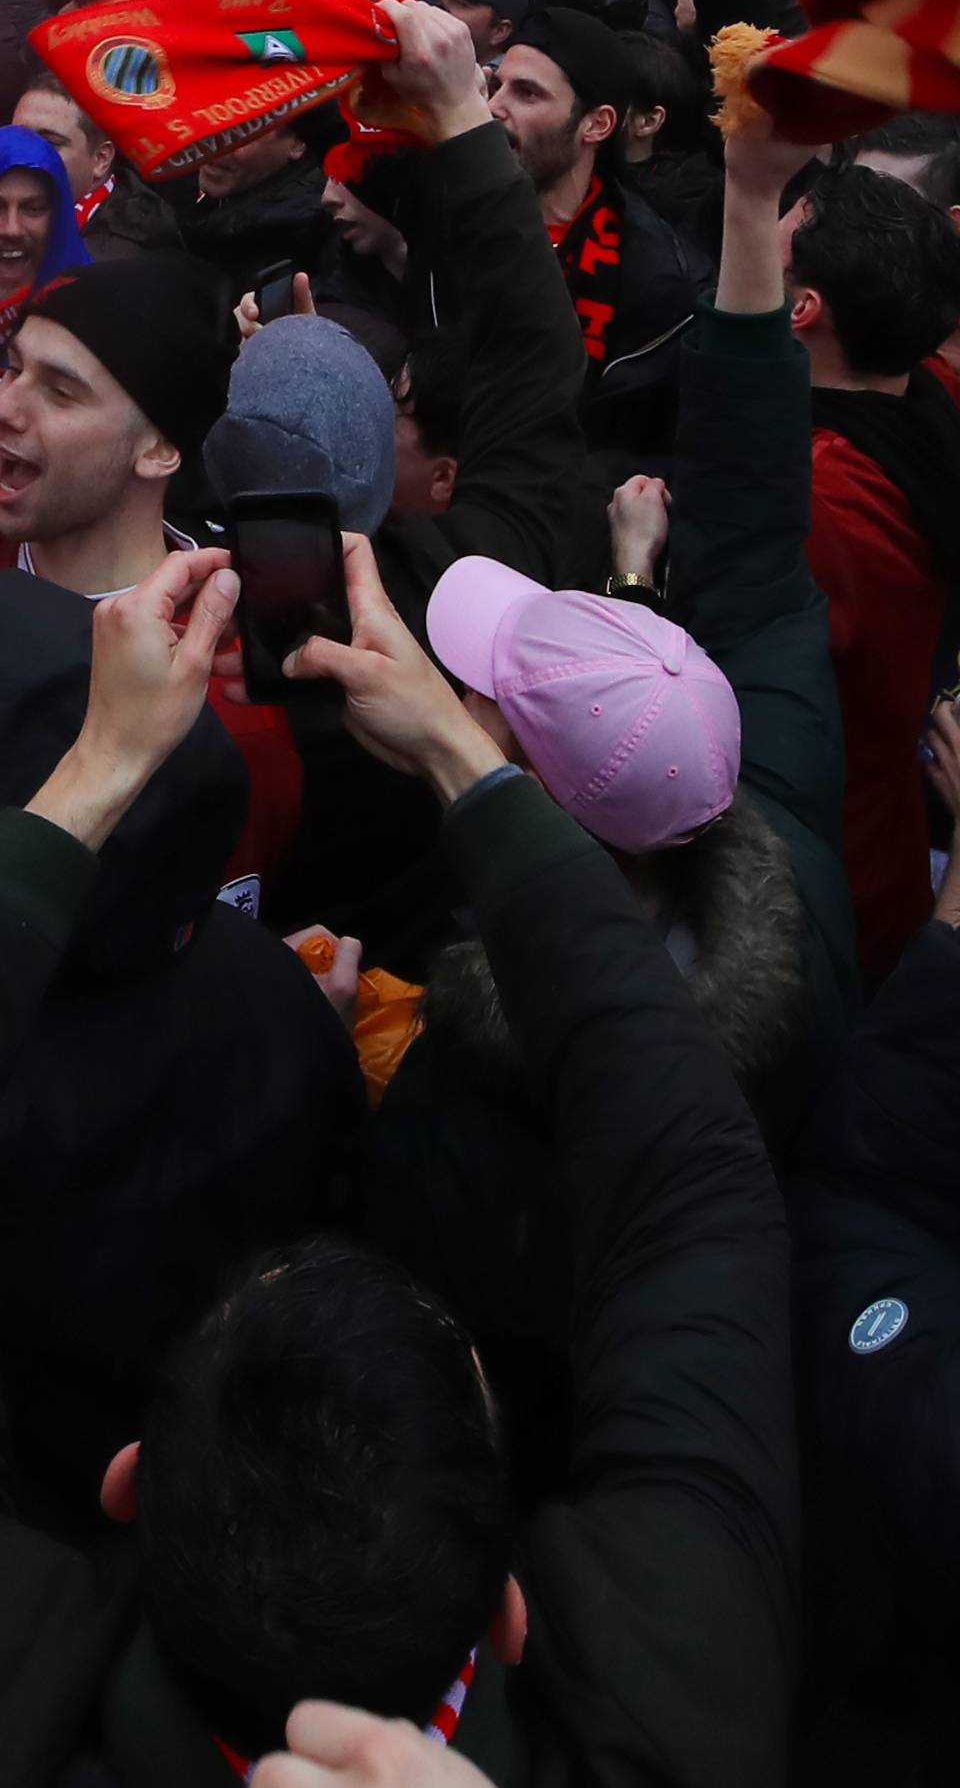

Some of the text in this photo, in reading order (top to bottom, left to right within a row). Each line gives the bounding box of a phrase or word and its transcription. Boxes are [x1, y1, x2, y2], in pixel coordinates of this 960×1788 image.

[47, 8, 161, 51] Wembley
[191, 64, 325, 126] LIVERPOOL
[165, 117, 193, 142] 5
